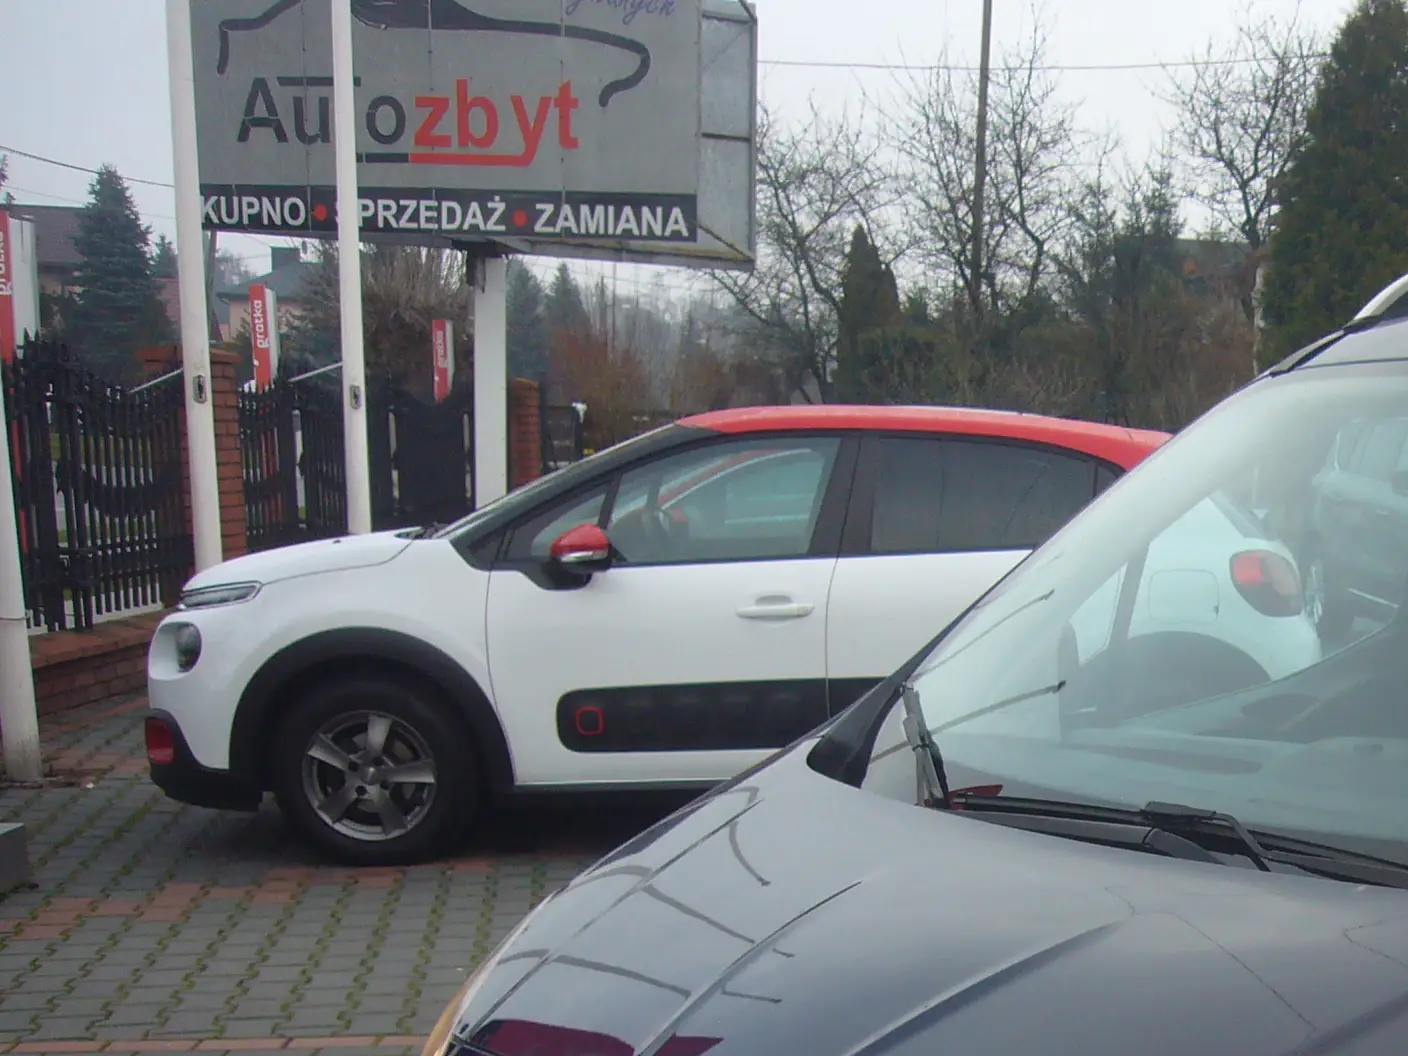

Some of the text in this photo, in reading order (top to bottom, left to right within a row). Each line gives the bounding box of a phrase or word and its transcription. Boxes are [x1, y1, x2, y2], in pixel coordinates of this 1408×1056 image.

[200, 195, 689, 238] KUPNO PRZEDAŻ ZAMIANA
[253, 299, 270, 348] gratka
